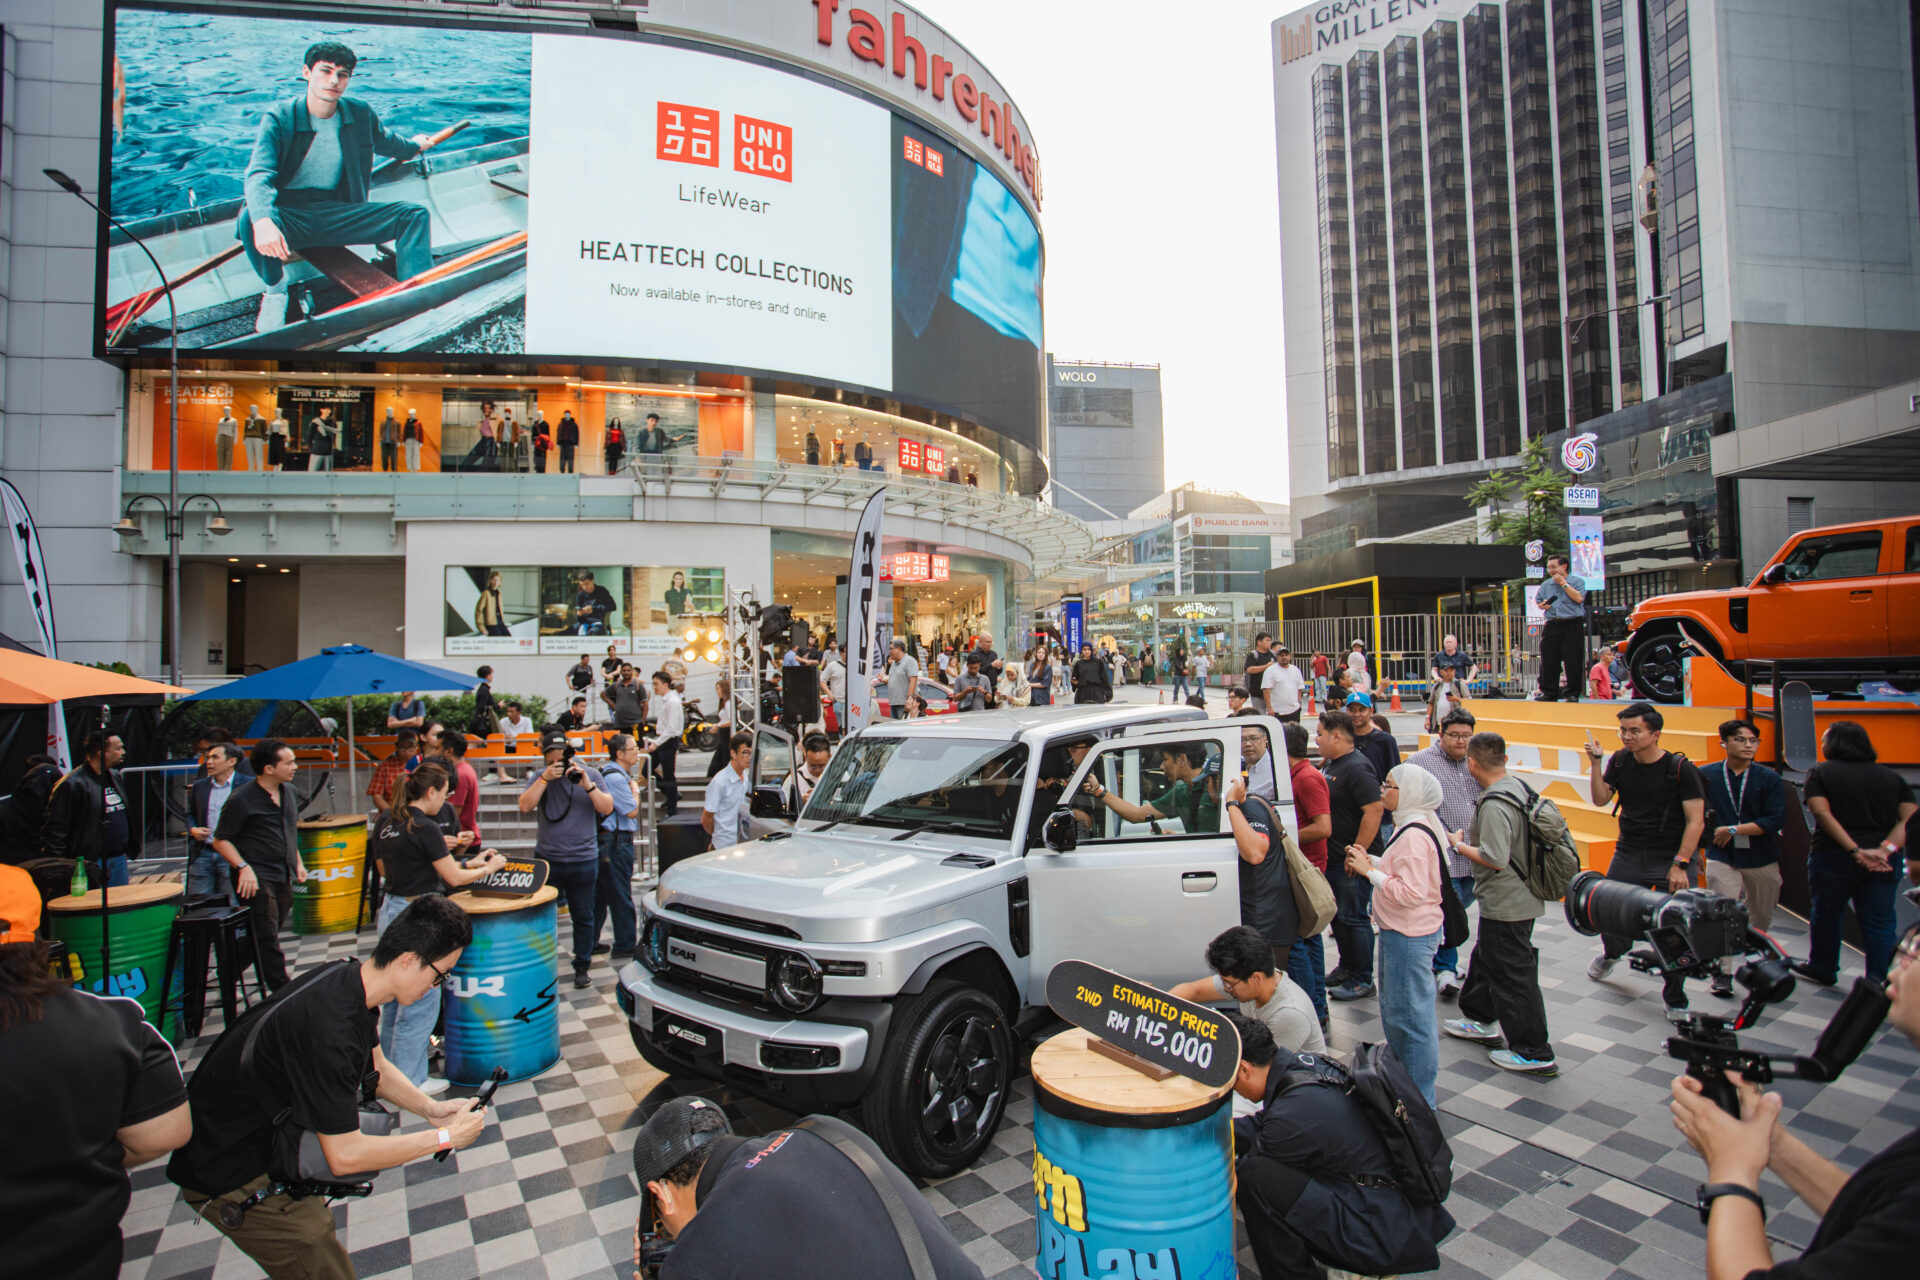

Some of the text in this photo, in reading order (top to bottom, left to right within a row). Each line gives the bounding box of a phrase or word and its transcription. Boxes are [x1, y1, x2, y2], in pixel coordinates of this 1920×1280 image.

[1316, 0, 1439, 51] MILLEN
[679, 183, 771, 214] LifeWear
[580, 240, 854, 296] HEATTECH COLLECTIONS
[610, 283, 640, 297] Now
[645, 286, 701, 303] available
[767, 302, 789, 315] and
[793, 305, 829, 323] online.
[292, 388, 312, 397] THIN
[315, 389, 331, 398] YET
[1058, 371, 1097, 383] WOLO
[1568, 488, 1597, 499] ASEAN
[1172, 602, 1219, 617] Tutti Frutti
[1075, 986, 1103, 1008] 2WD
[1112, 984, 1220, 1041] ESTIMATED PRICE
[1106, 1009, 1213, 1069] RM 145,000
[744, 1132, 791, 1169] driven
